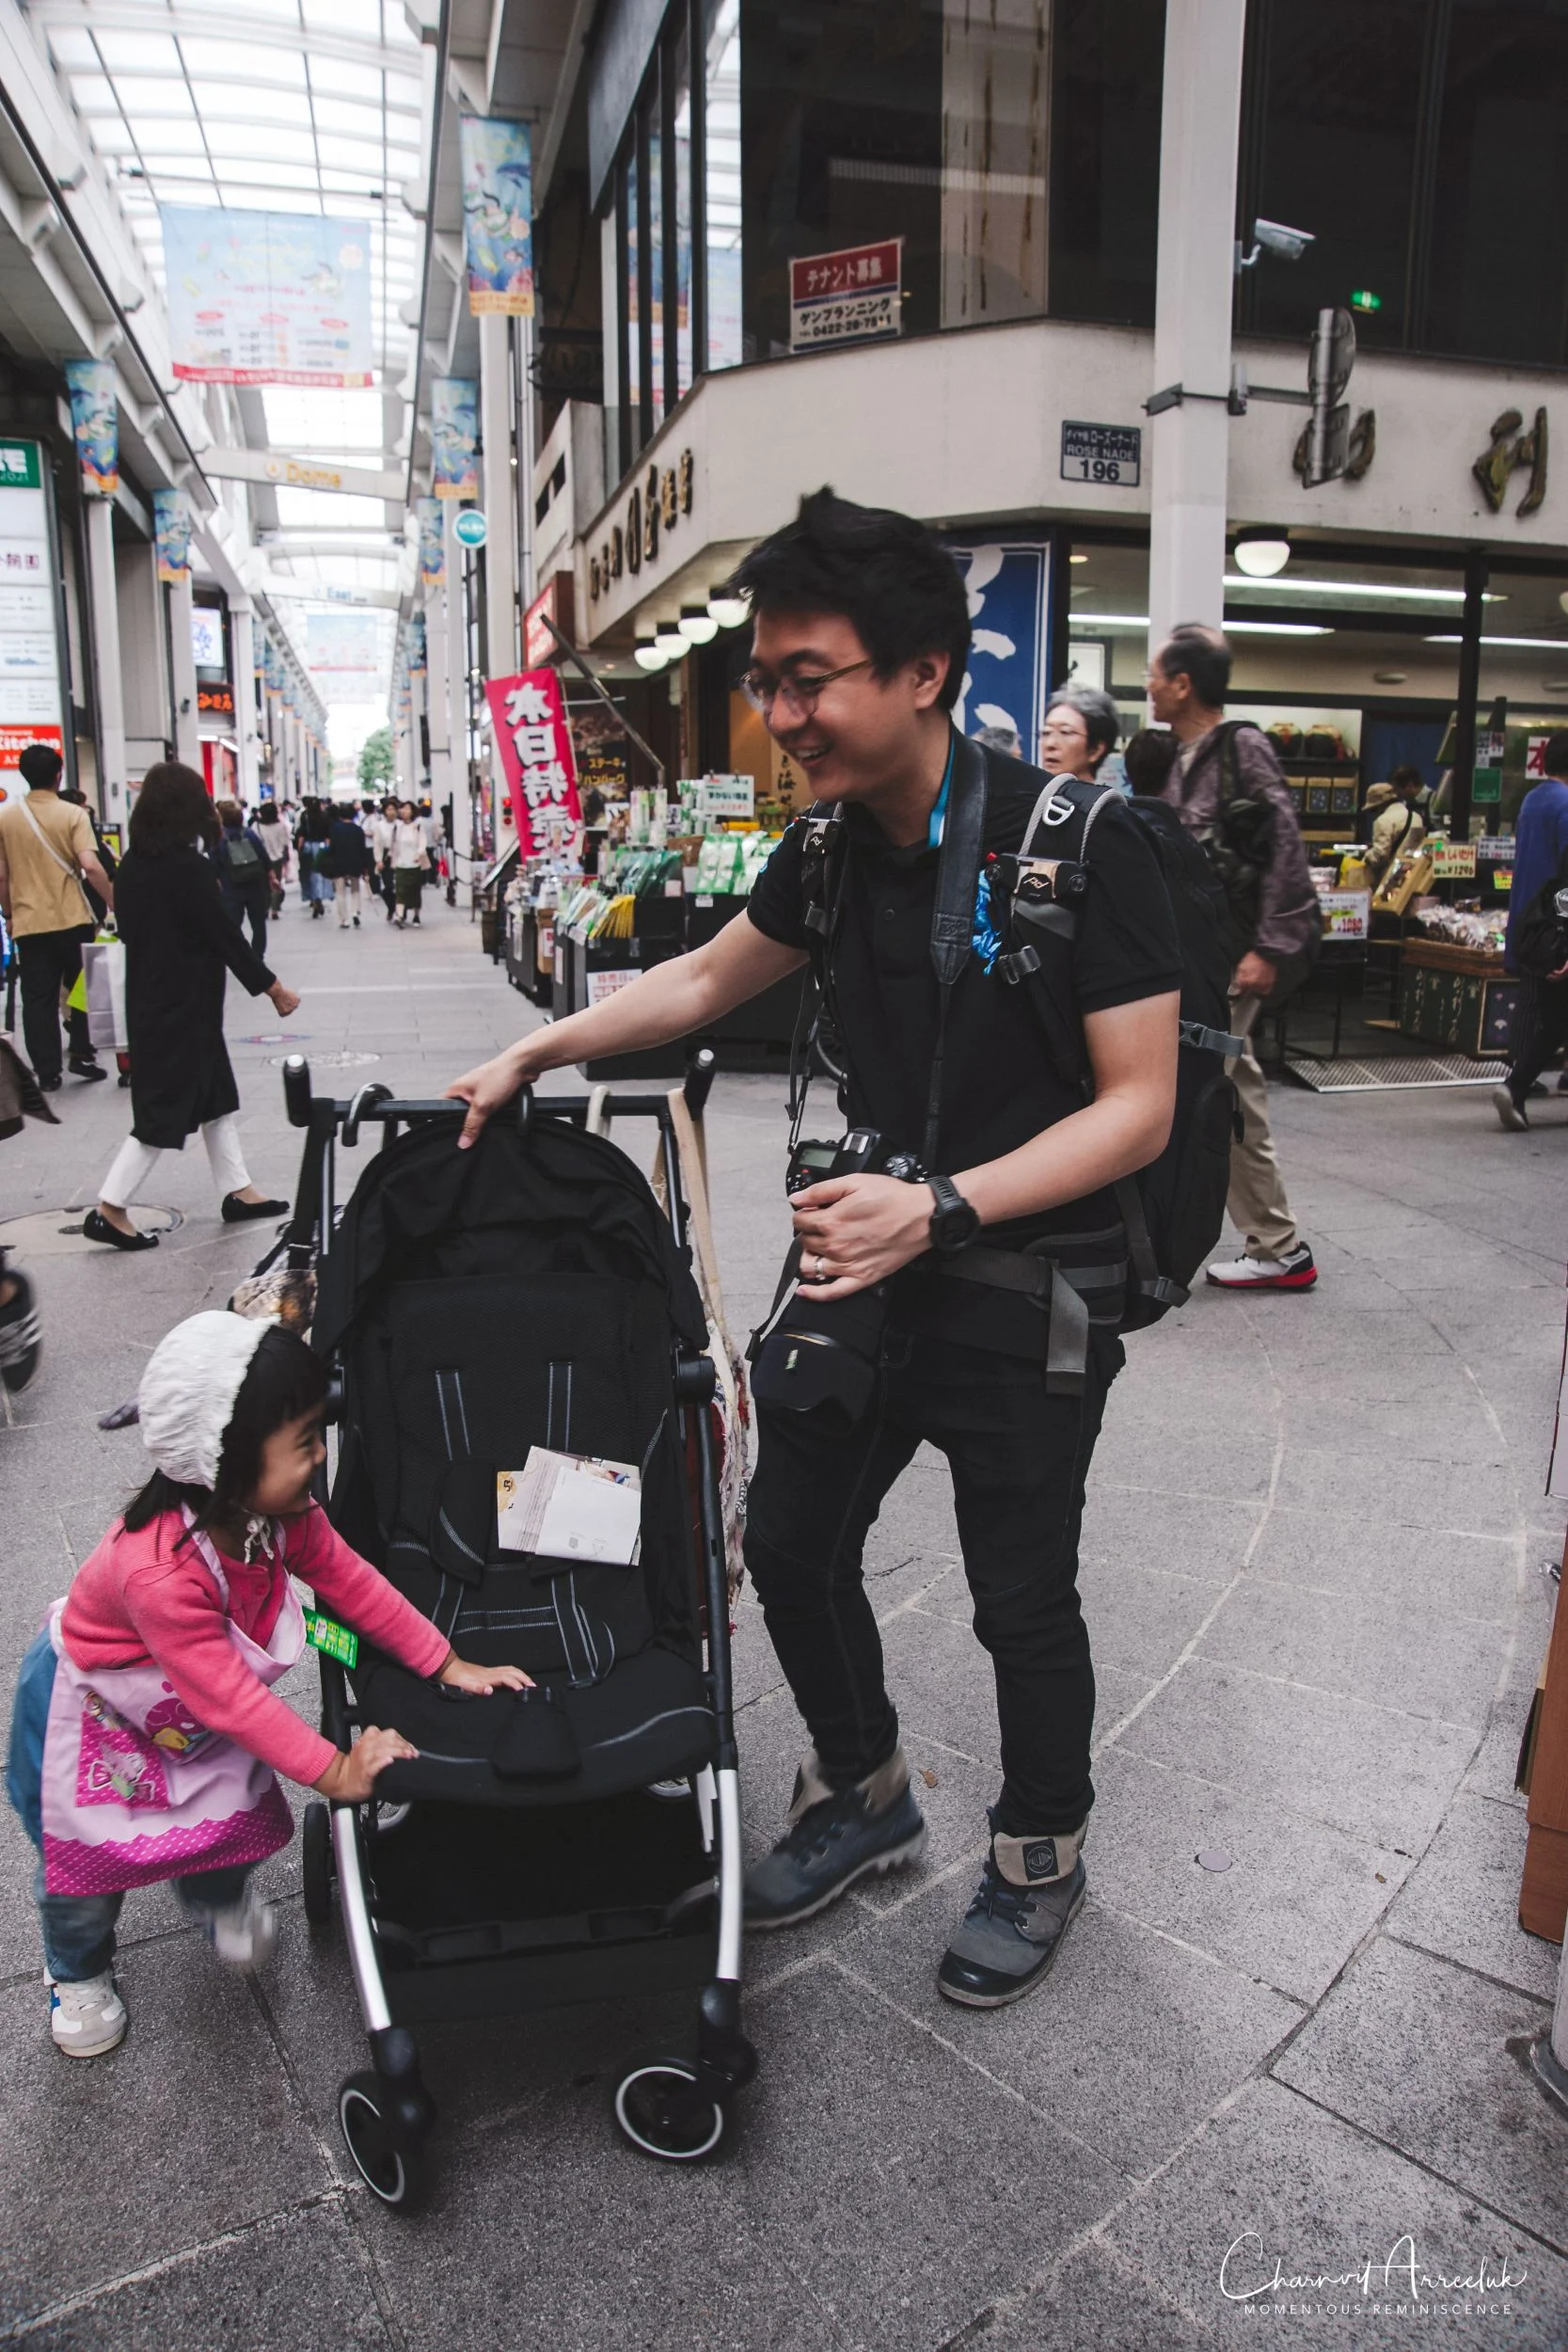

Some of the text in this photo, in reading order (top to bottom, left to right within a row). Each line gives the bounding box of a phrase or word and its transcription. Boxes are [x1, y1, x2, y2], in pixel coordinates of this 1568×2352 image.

[807, 256, 882, 293] テナント募集
[1067, 443, 1134, 461] ROSE NADE
[287, 462, 342, 488] Dome
[1079, 458, 1121, 482] 196
[588, 756, 622, 769] ステーキ
